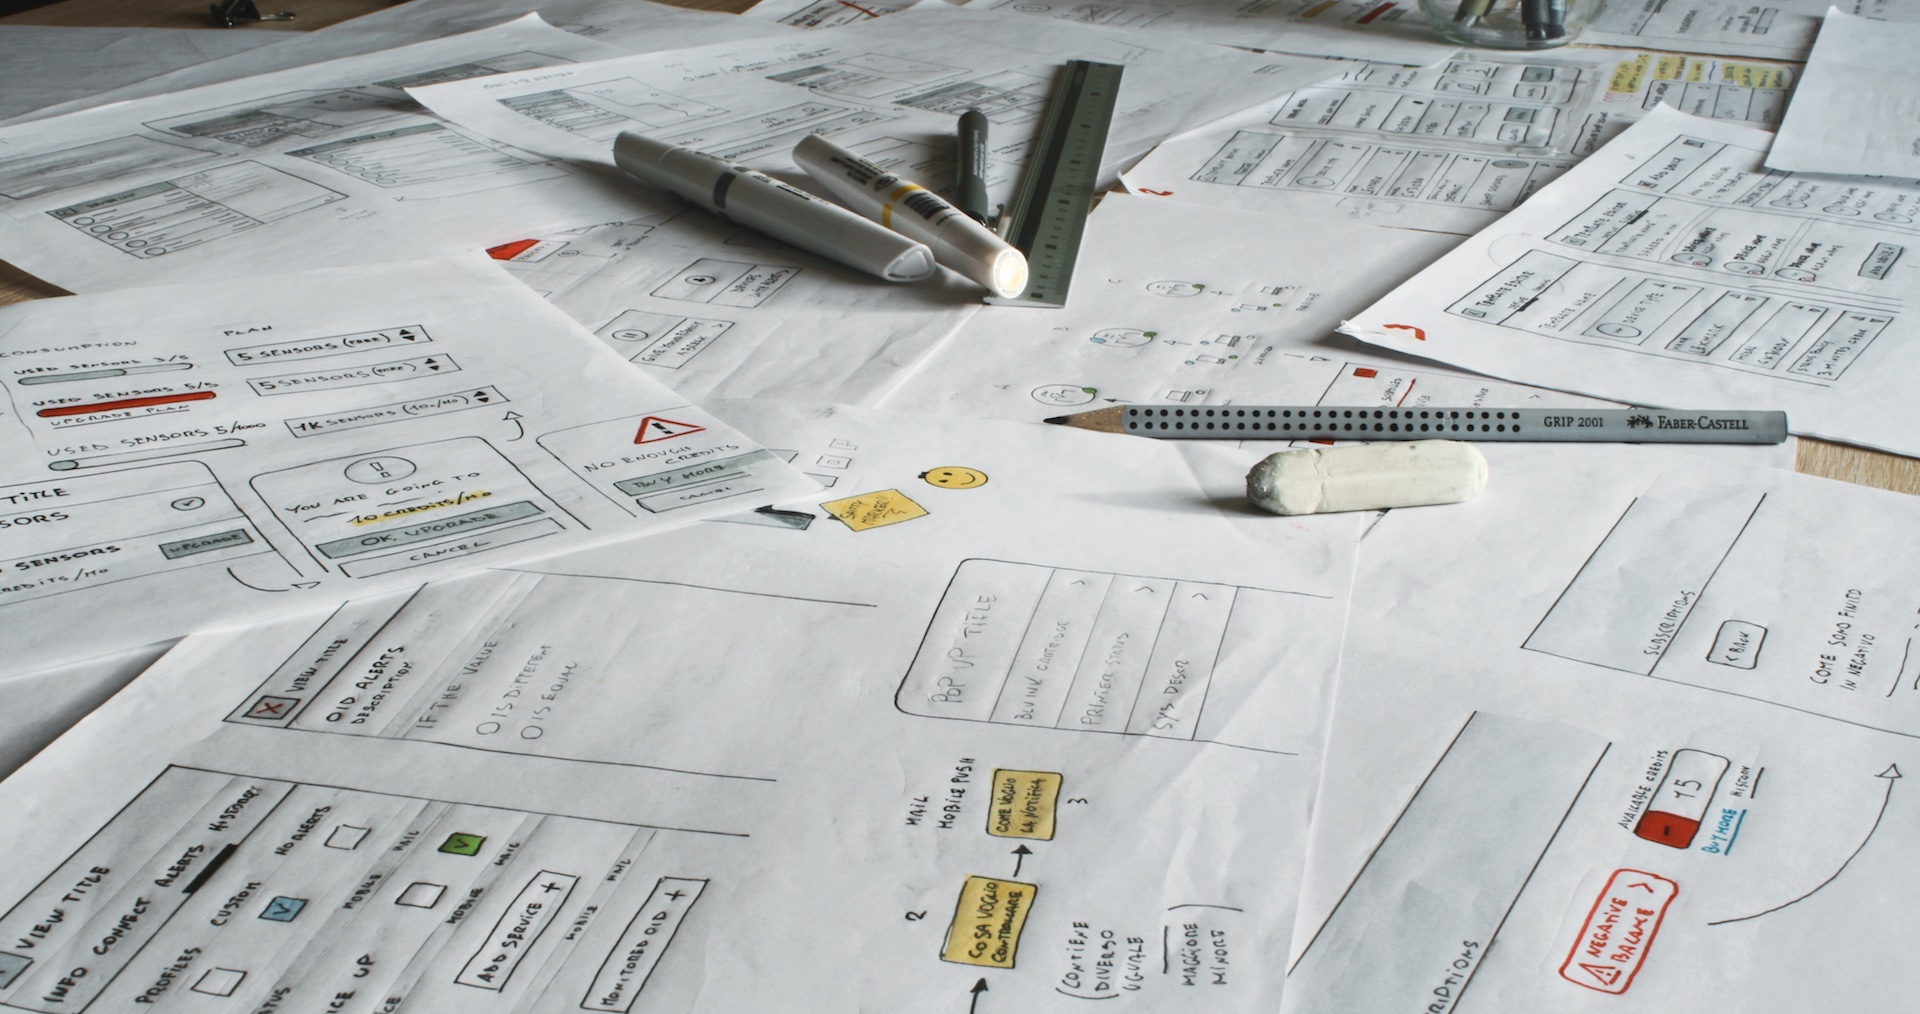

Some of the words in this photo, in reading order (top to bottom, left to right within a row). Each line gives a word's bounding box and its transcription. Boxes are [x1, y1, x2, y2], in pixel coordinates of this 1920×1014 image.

[223, 325, 273, 337] PLAN
[0, 341, 138, 359] CONSUMPTION
[237, 352, 253, 362] 5
[260, 342, 339, 359] SENSORS
[13, 365, 60, 377] USED
[69, 359, 142, 371] SENSORS
[152, 353, 190, 363] 3/5
[32, 396, 83, 408] USED
[93, 386, 174, 401] SENSORS
[184, 381, 219, 391] 5/5
[258, 380, 278, 391] 5
[278, 370, 372, 388] SENSORS
[50, 411, 133, 427] UPGRADE
[145, 404, 190, 414] PLAN
[326, 410, 397, 427] SENSORS
[1543, 416, 1574, 428] GRIP
[1577, 416, 1605, 428] 2001
[1657, 415, 1750, 431] FABER-CASTELL
[47, 443, 109, 457] USED
[120, 428, 209, 447] SENSORS
[664, 443, 740, 465] CREDITS
[583, 461, 616, 473] NO
[620, 445, 693, 465] ENOUGH
[8, 487, 70, 505] TITLE
[284, 502, 321, 515] YOU
[332, 493, 369, 506] ARE
[385, 479, 446, 496] GOING
[451, 471, 481, 482] TO
[347, 513, 378, 525] 10
[404, 512, 501, 537] UPGRADE
[169, 533, 243, 553] UPGRADE
[409, 541, 492, 562] CANCEL
[15, 545, 122, 571] SENSORS
[0, 568, 109, 594] REDITS/MO
[1837, 588, 1862, 619] FINITO
[947, 646, 975, 674] UP
[963, 593, 997, 639] TITLE
[1643, 589, 1696, 656] SUBSCRIPTIONS
[1828, 622, 1852, 648] SONO
[1729, 631, 1750, 655] BACK
[1846, 633, 1876, 677] NEGATIVO
[285, 665, 317, 693] VIEW
[315, 637, 348, 665] TITLE
[355, 645, 405, 690] ALERTS
[1080, 672, 1114, 726] PRINTER
[1106, 631, 1130, 666] STATUS
[1809, 654, 1836, 685] COME
[350, 661, 415, 725] DESCRIPTION
[415, 714, 438, 729] IF
[430, 683, 462, 710] THE
[461, 640, 499, 676] VALUE
[530, 705, 552, 721] IS
[541, 661, 578, 701] EQUAL
[1839, 679, 1857, 691] IN
[490, 702, 514, 718] IS
[950, 756, 976, 784] PUSH
[999, 777, 1017, 806] VOGLIO
[1617, 784, 1651, 831] AVAILABLE
[1646, 749, 1669, 783] CREDITS
[905, 795, 930, 826] MAIL
[936, 788, 966, 829] MOBILE
[995, 807, 1013, 833] COME
[1701, 832, 1729, 855] BUY
[342, 873, 383, 910] MOBILE
[391, 829, 420, 852] MAIL
[15, 907, 65, 951] VIEW
[62, 865, 111, 903] TITLE
[134, 945, 203, 1005] PROFILES
[209, 880, 263, 927] CUSTOM
[274, 842, 295, 857] NO
[291, 805, 333, 841] ALERTS
[445, 886, 485, 925] MOBILE
[41, 966, 89, 1004] INFO
[92, 896, 152, 956] CONNECT
[153, 843, 205, 888] ALERTS
[968, 921, 993, 959] COSA
[984, 881, 1000, 920] VOGLIO
[1585, 896, 1628, 959] NEGATIVE
[476, 953, 508, 983] ADD
[501, 901, 543, 949] SERVICE
[1610, 906, 1656, 964] BALANCE
[353, 953, 377, 979] UP
[1094, 928, 1118, 992] DIVERSO
[1180, 922, 1201, 988] MAGGIORE
[1211, 928, 1229, 986] MINORE
[599, 939, 649, 1006] MONITORED
